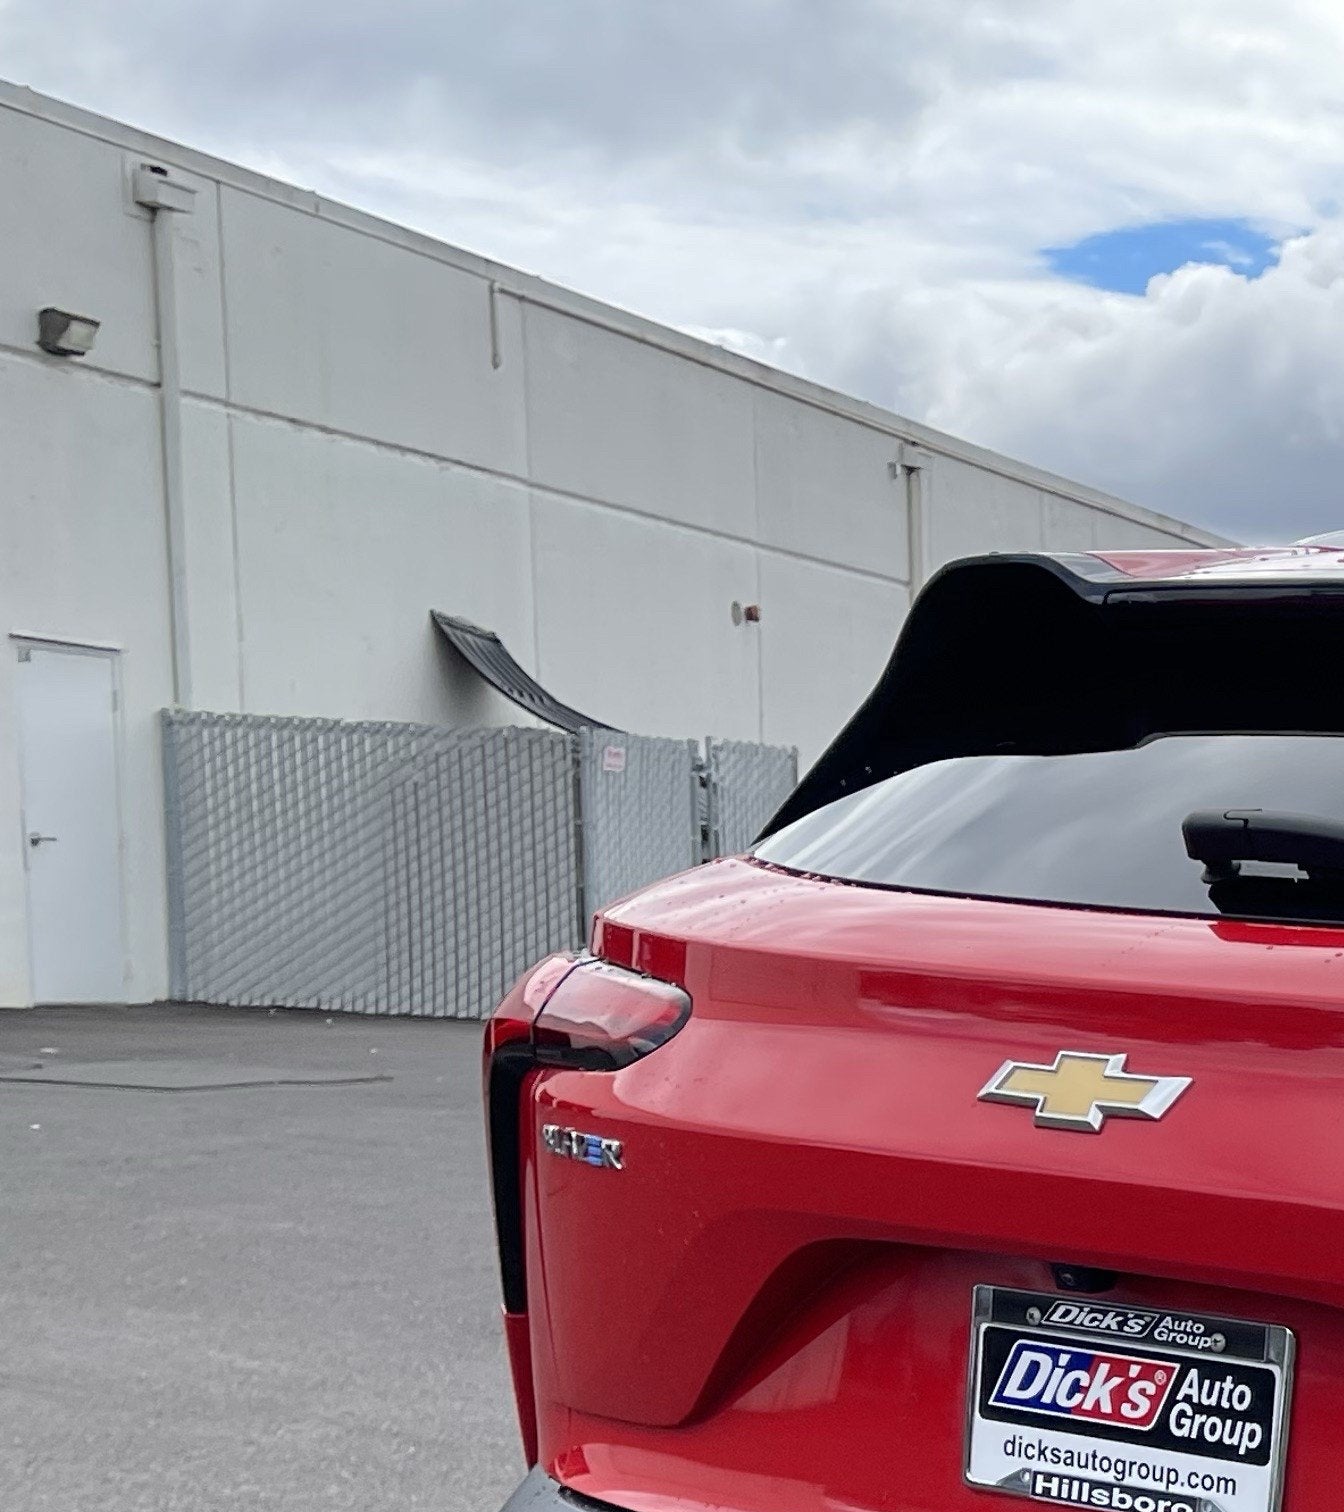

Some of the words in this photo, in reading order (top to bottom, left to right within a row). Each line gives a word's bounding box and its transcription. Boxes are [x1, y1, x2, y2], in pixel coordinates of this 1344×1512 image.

[1049, 1303, 1149, 1334] Dick's
[1153, 1326, 1213, 1350] Group
[1158, 1316, 1205, 1335] Auto
[1002, 1350, 1157, 1419] Dick's
[1176, 1368, 1252, 1412] Auto
[1169, 1403, 1263, 1455] Group
[1003, 1435, 1237, 1497] dicksautogroup.com
